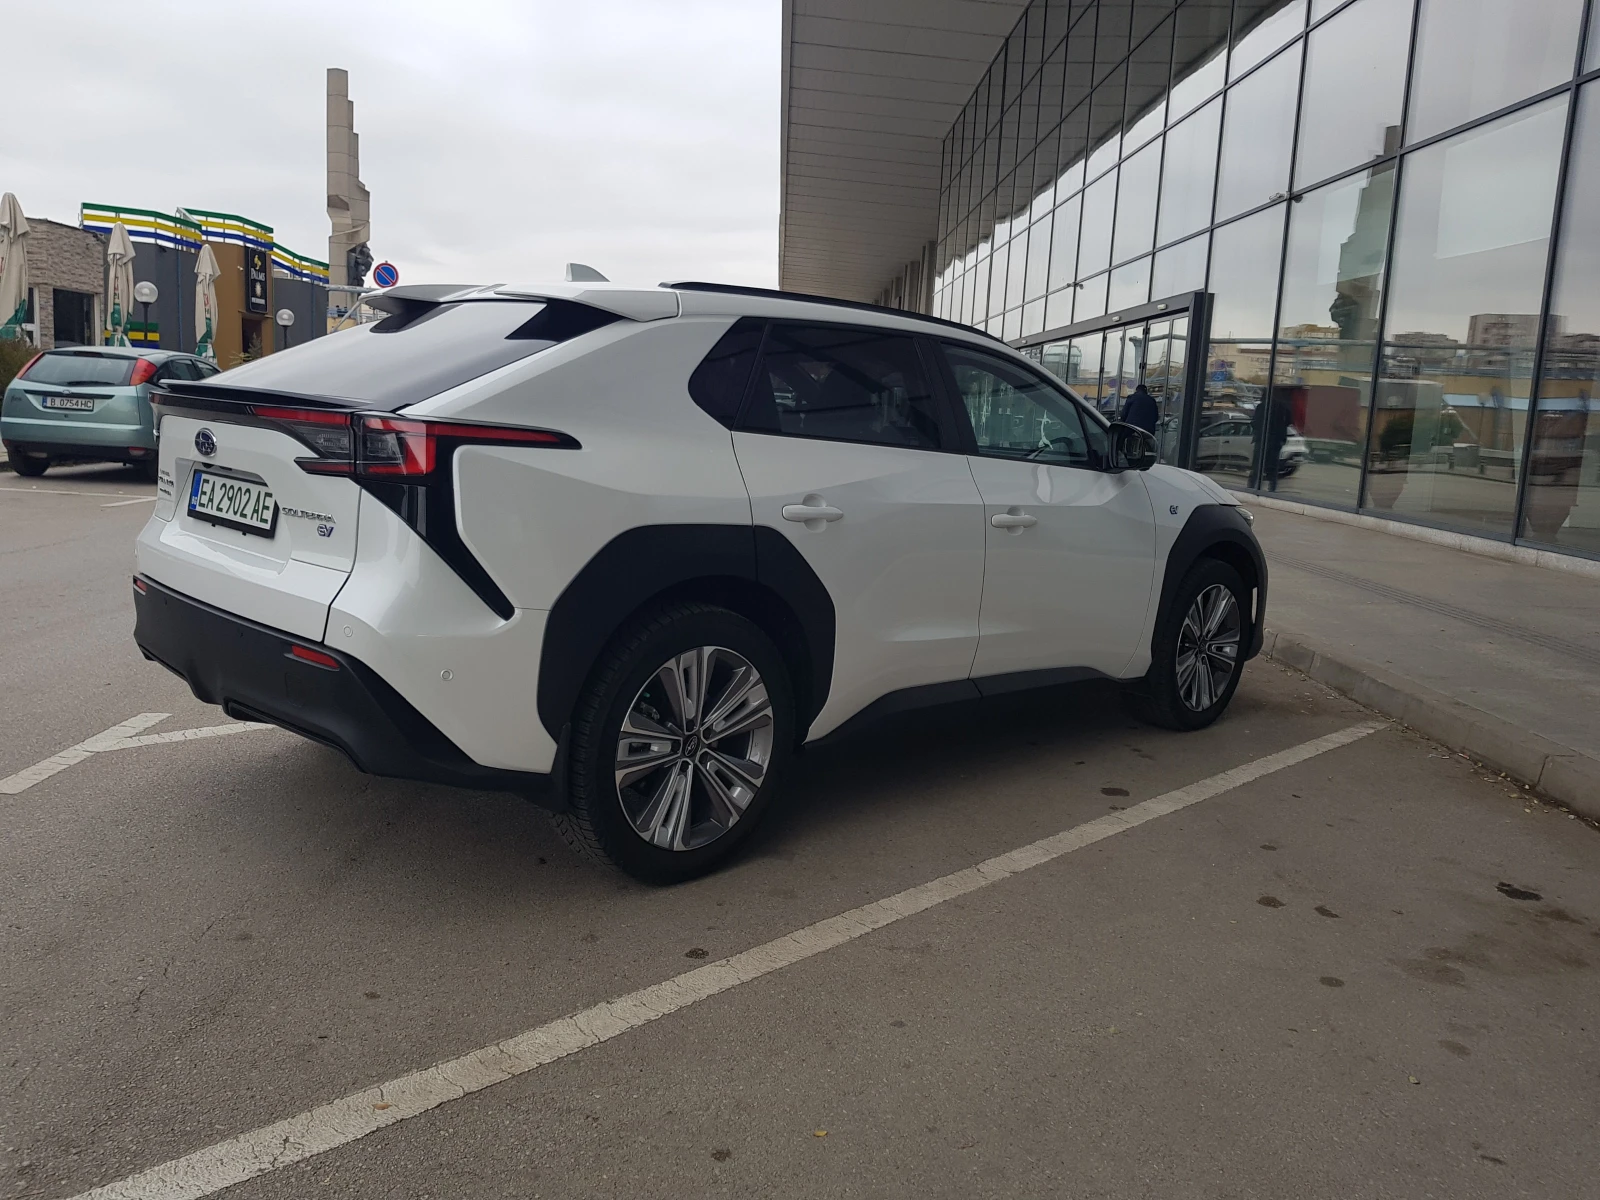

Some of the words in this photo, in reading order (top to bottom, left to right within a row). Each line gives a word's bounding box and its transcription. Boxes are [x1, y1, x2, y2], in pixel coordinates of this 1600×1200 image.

[50, 398, 56, 406] B
[59, 399, 79, 408] 0754
[80, 400, 92, 409] HC
[198, 478, 216, 511] EA
[215, 482, 252, 520] 2902
[250, 490, 273, 525] AE
[281, 507, 336, 524] SOLTERRA
